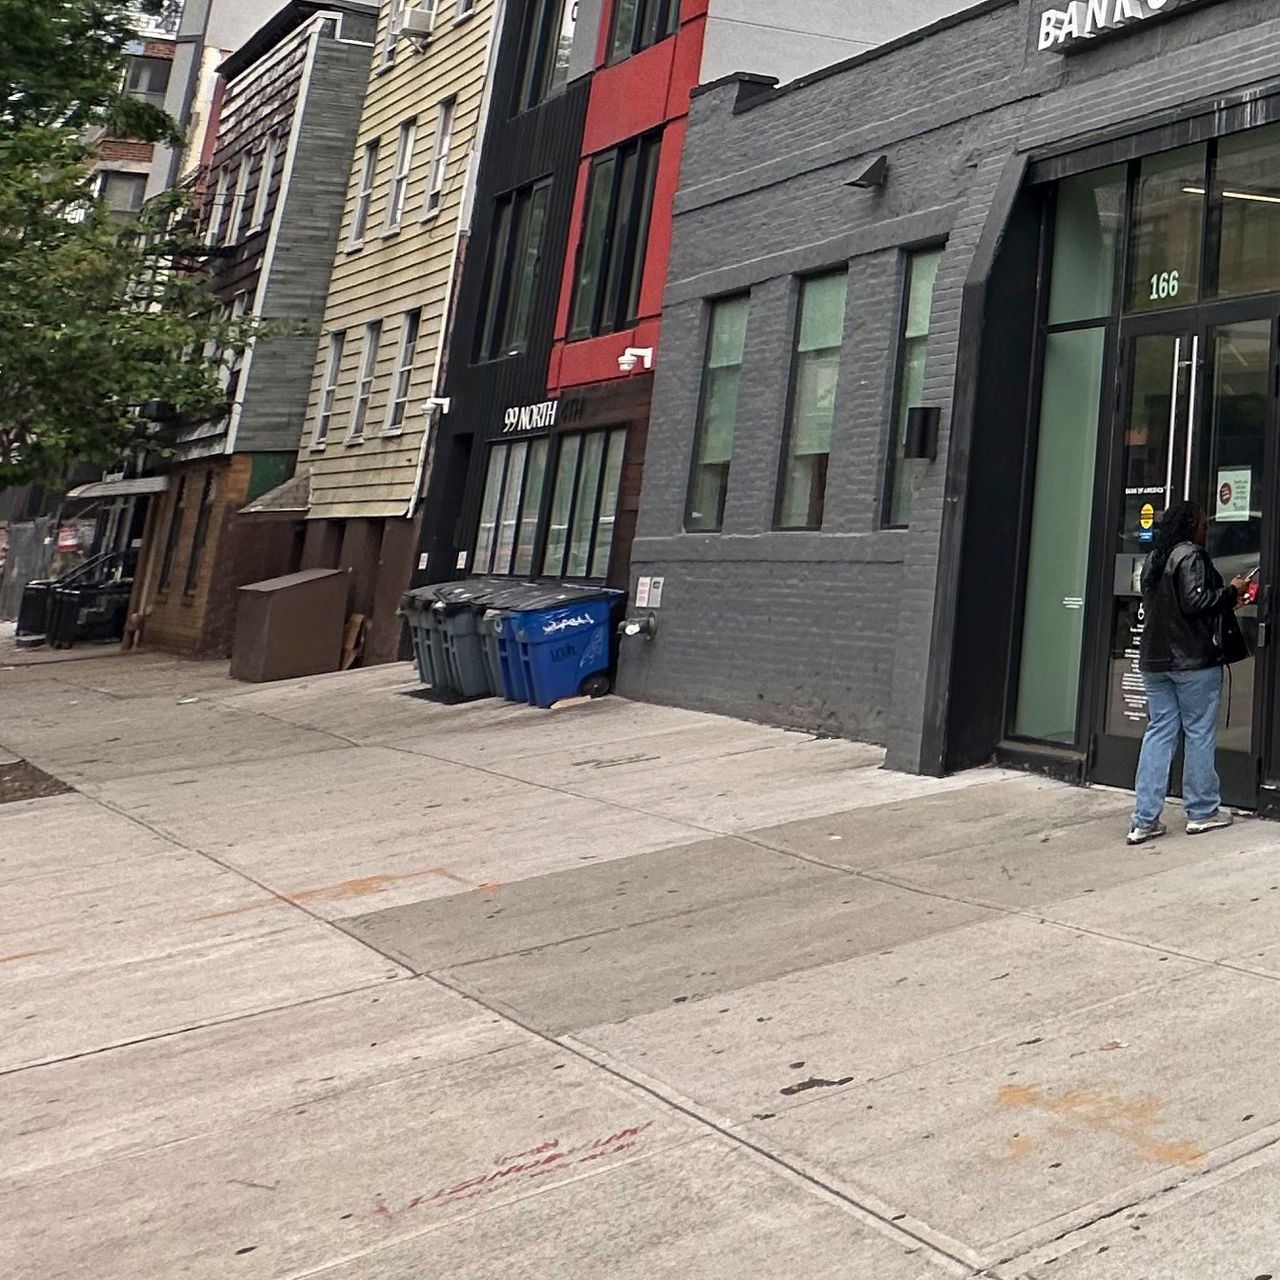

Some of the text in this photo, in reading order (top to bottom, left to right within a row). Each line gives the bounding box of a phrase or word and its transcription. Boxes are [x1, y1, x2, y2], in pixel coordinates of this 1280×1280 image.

[1150, 270, 1179, 300] 166
[503, 407, 518, 433] 99
[517, 400, 558, 431] NORTH
